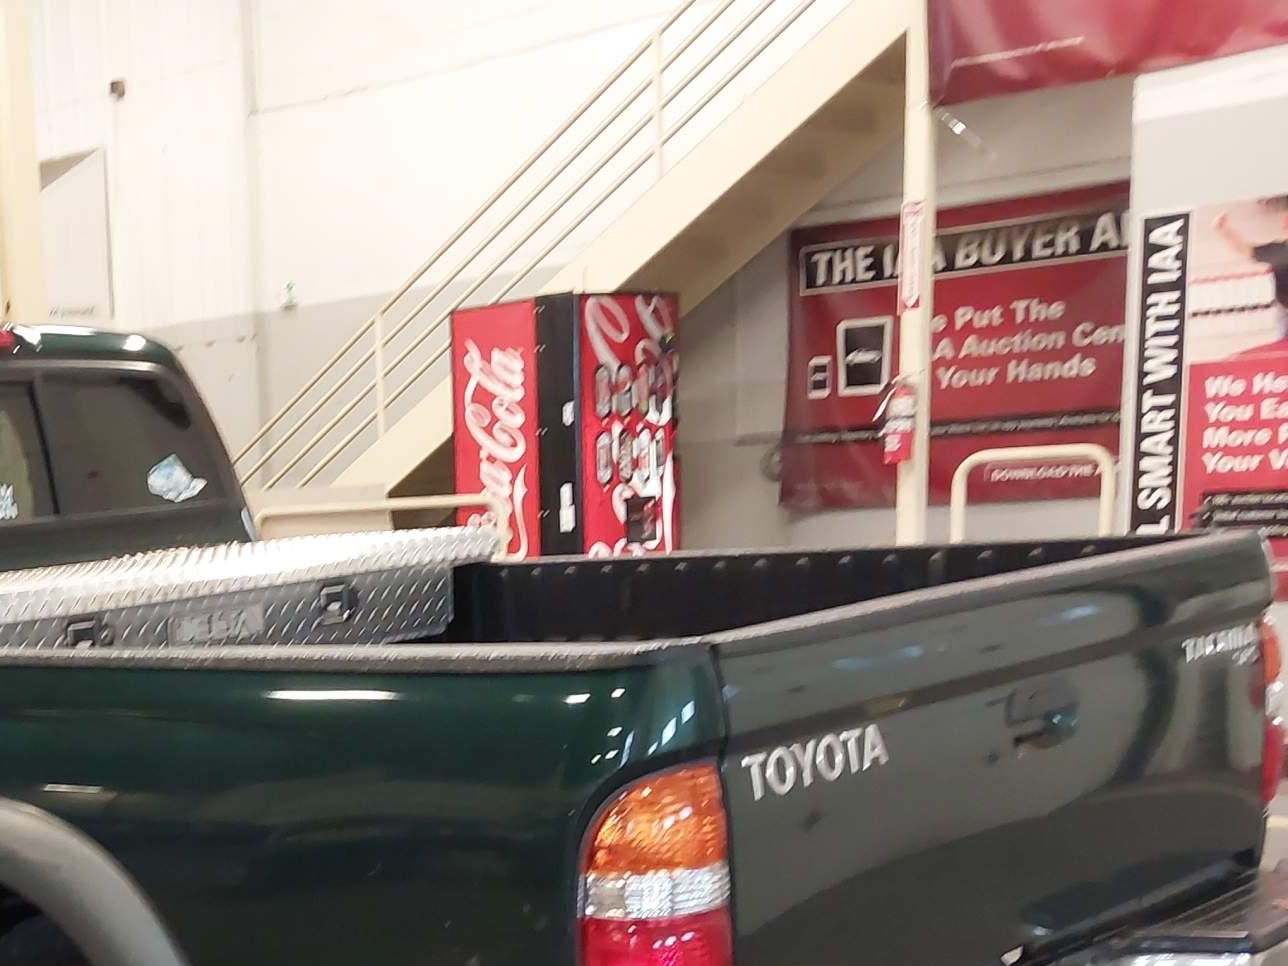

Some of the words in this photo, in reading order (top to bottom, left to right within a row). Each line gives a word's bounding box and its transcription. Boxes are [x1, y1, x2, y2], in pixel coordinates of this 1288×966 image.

[812, 246, 876, 286] THE
[954, 222, 1081, 270] BUYER
[1147, 217, 1185, 285] IAA
[954, 305, 1004, 331] Put
[1009, 297, 1066, 325] The
[958, 331, 1066, 360] Auction
[1072, 321, 1125, 347] Cen
[1142, 290, 1182, 385] WITH
[936, 365, 1000, 389] Your
[1006, 352, 1097, 384] Hands
[1204, 375, 1247, 398] We
[1203, 400, 1254, 423] You
[1137, 388, 1176, 510] SMART
[1202, 425, 1272, 449] More
[1200, 451, 1264, 475] Your
[741, 724, 889, 801] TOYOTA
